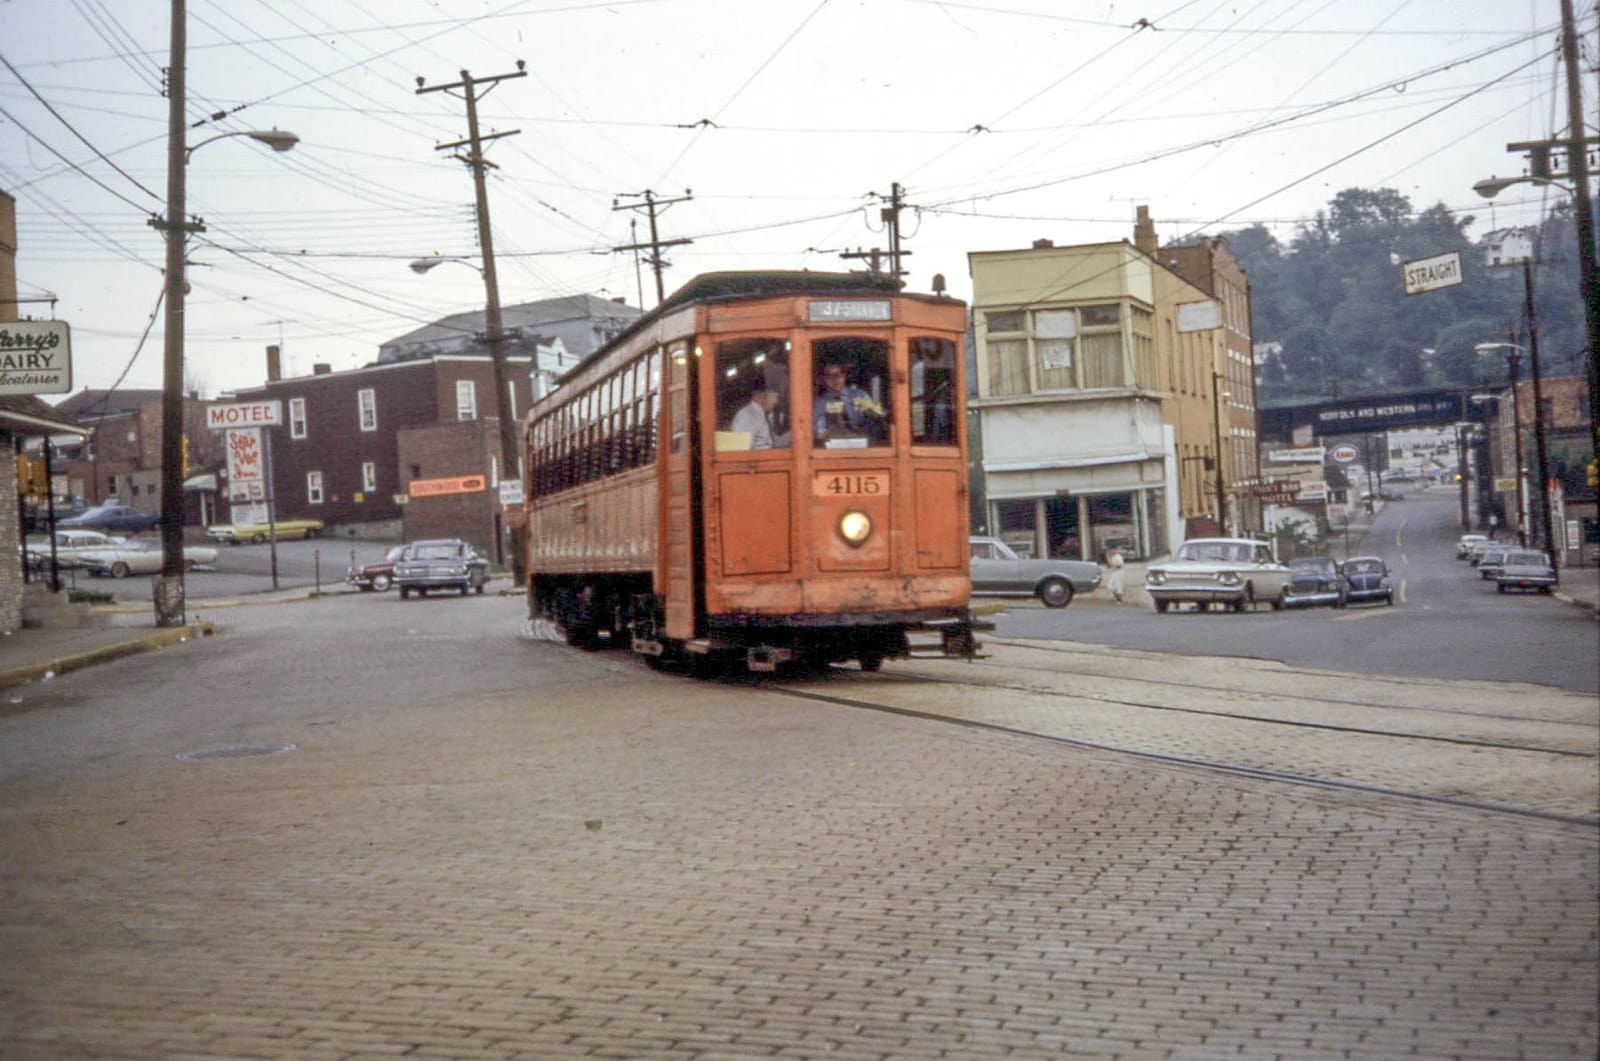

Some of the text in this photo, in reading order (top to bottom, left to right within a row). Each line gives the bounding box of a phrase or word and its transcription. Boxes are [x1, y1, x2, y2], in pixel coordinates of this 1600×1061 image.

[1409, 260, 1456, 286] STRAIGHT
[0, 353, 54, 369] AIRY
[211, 406, 273, 424] MOTEL
[1358, 408, 1375, 417] AND
[1376, 405, 1415, 416] WESTERN
[827, 476, 880, 494] 4115
